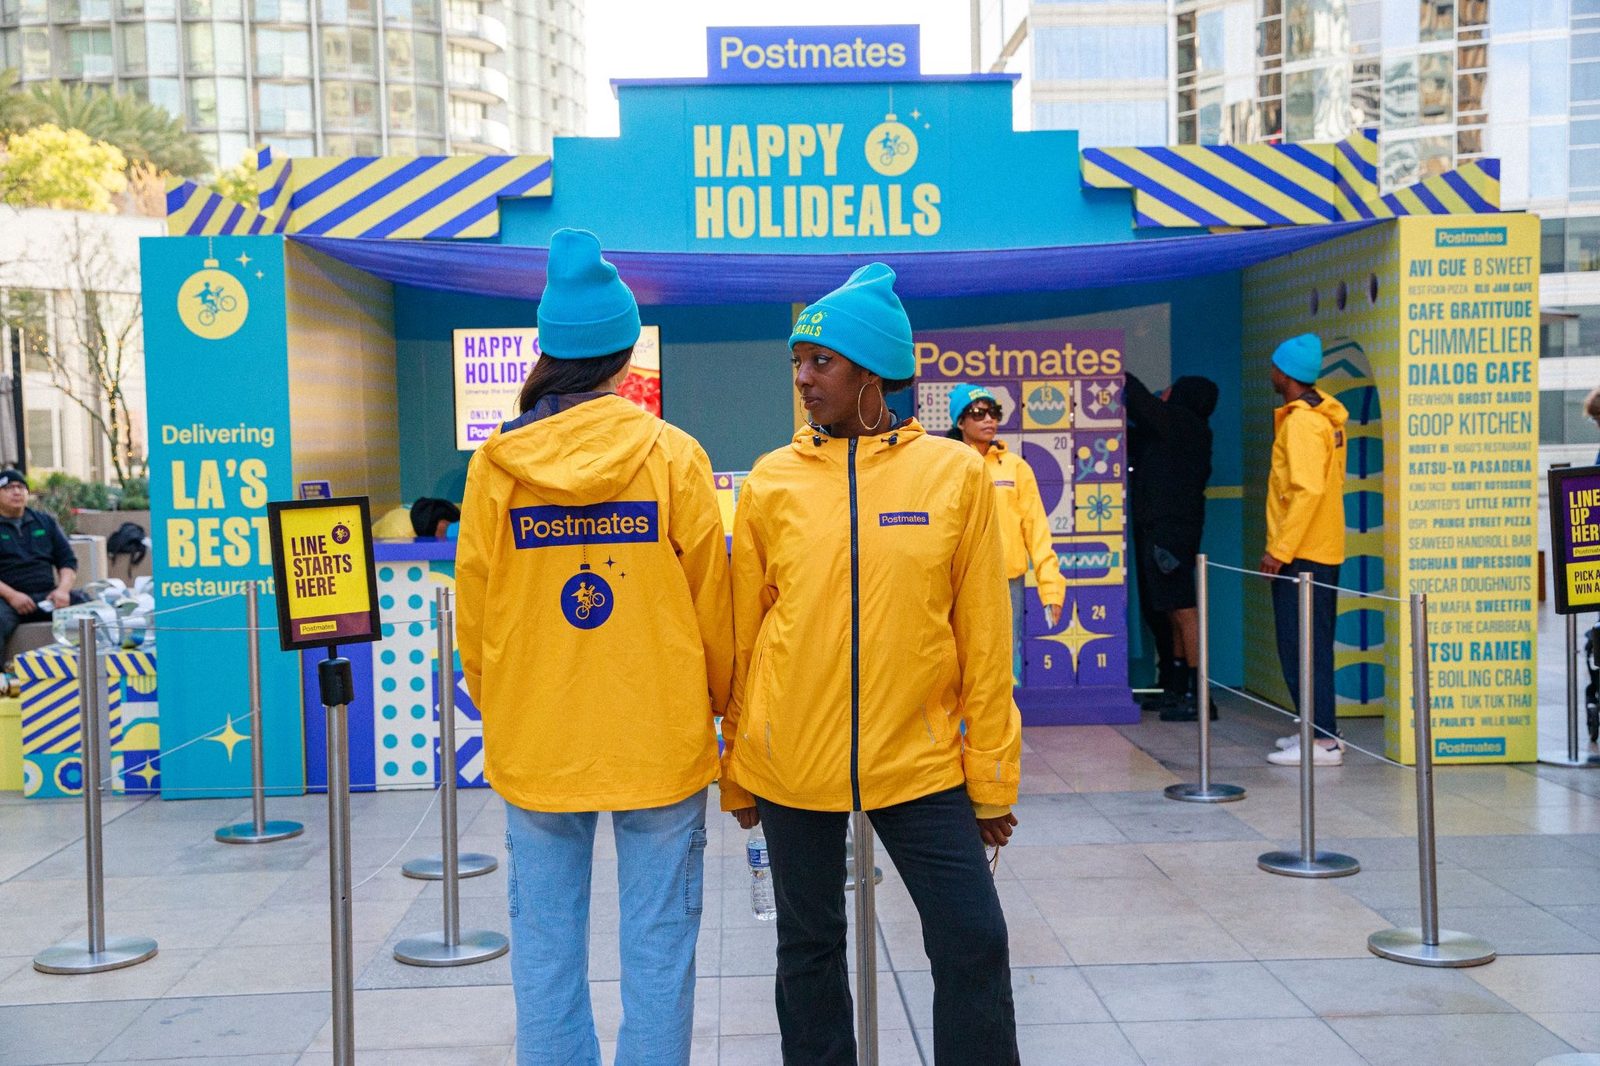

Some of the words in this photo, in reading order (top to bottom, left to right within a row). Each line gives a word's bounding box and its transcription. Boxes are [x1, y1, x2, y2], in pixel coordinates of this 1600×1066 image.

[720, 36, 906, 69] Postmates
[693, 123, 844, 177] HAPPY
[695, 183, 942, 238] HOLIDEALS
[1439, 231, 1504, 243] Postmates
[1409, 259, 1432, 277] AVI
[1473, 258, 1482, 276] B
[1486, 256, 1532, 275] SWEET
[1447, 284, 1468, 294] PIZZA
[1493, 283, 1510, 293] JAM
[1513, 282, 1532, 292] CAFE
[1408, 302, 1444, 320] CAFE
[1451, 300, 1532, 319] GRATITUDE
[464, 336, 523, 357] HAPPY
[1408, 326, 1532, 355] CHIMMELIER
[914, 342, 1121, 377] Postmates
[465, 361, 536, 384] HOLIDE
[1408, 362, 1477, 385] DIALOG
[1486, 361, 1532, 383] CAFE
[926, 392, 934, 406] 6
[1099, 392, 1110, 405] 15
[1408, 394, 1454, 406] EREWHON
[1458, 392, 1492, 405] GHOST
[1497, 391, 1532, 404] SANDO
[470, 410, 489, 420] ONLY
[492, 410, 502, 420] ON
[1408, 412, 1453, 436] GOOP
[1459, 410, 1532, 434] KITCHEN
[161, 423, 275, 448] Delivering
[1054, 436, 1067, 449] 20
[1484, 442, 1531, 451] RESTAURANT
[1113, 463, 1120, 477] 9
[1409, 460, 1466, 474] KATSU-YA
[1470, 459, 1531, 473] PASADENA
[171, 458, 268, 510] LA'S
[1466, 497, 1498, 509] LITTLE
[1502, 496, 1531, 508] FATTY
[1568, 488, 1600, 508] LINE
[881, 515, 926, 523] Postmates
[1055, 516, 1068, 530] 22
[1433, 518, 1464, 528] PRINCE
[1469, 517, 1501, 527] STREET
[1505, 516, 1531, 526] PIZZA
[1570, 507, 1590, 525] UP
[519, 512, 649, 540] Postmates
[1571, 523, 1600, 543] HER
[167, 516, 272, 568] BEST
[291, 535, 327, 557] LINE
[1408, 536, 1454, 550] SEAWEED
[1457, 535, 1508, 549] HANDROLL
[1512, 534, 1532, 547] BAR
[293, 554, 353, 577] STARTS
[1409, 557, 1457, 570] SICHUAN
[1462, 555, 1531, 569] IMPRESSION
[1574, 569, 1595, 581] PICK
[295, 576, 337, 598] HERE
[1409, 577, 1458, 594] SIDECAR
[1461, 575, 1531, 592] DOUGHNUTS
[1575, 582, 1592, 595] WIN
[1091, 605, 1106, 620] 24
[1440, 600, 1471, 613] MAFIA
[1475, 599, 1531, 612] SWEETFIN
[302, 623, 335, 632] Postmates
[1441, 621, 1452, 633] OF
[1456, 621, 1473, 633] THE
[1476, 619, 1531, 632] CARIBBEAN
[1410, 642, 1462, 662] TSU
[1470, 640, 1532, 661] RAMEN
[1044, 655, 1052, 669] 5
[1097, 653, 1107, 667] 11
[1437, 669, 1491, 688] BOILING
[1495, 667, 1532, 686] CRAB
[1461, 695, 1481, 709] TUK
[1484, 694, 1505, 708] TUK
[1508, 693, 1532, 708] THAI
[1439, 741, 1501, 753] Postmates
